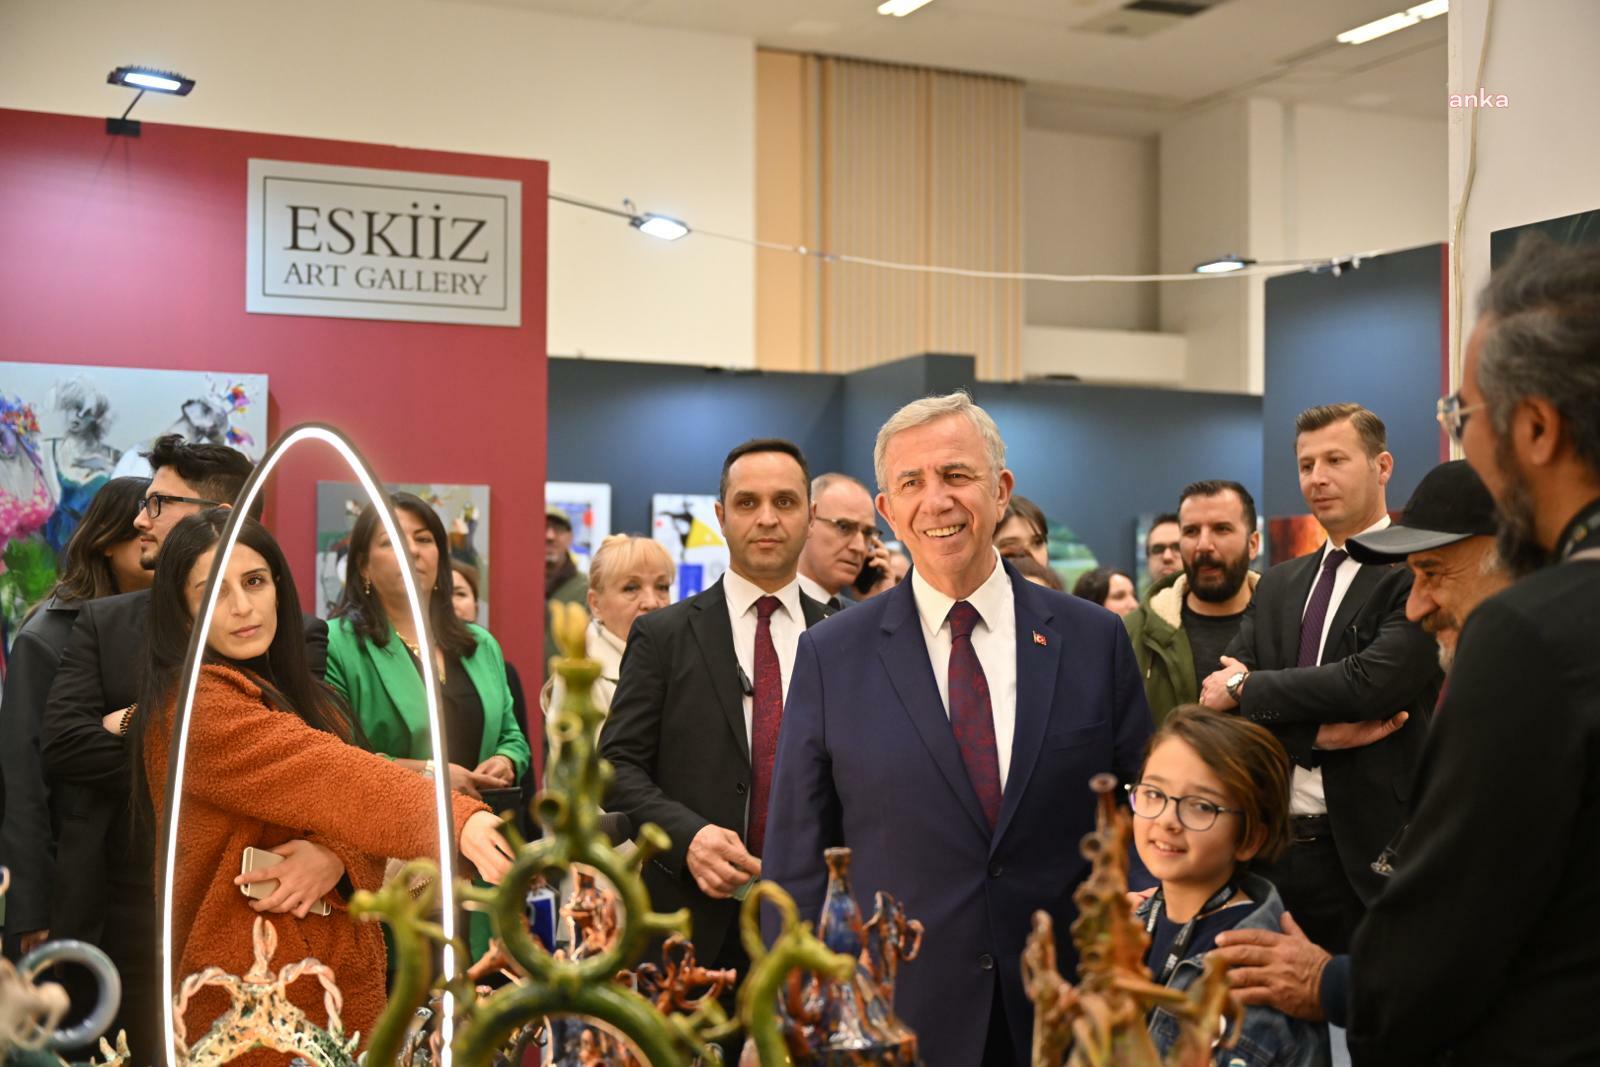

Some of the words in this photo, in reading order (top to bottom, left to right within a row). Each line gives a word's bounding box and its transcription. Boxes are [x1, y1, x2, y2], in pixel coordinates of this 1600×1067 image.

[284, 202, 489, 264] ESKİİZ
[284, 262, 346, 287] ART
[354, 267, 488, 296] GALLERY
